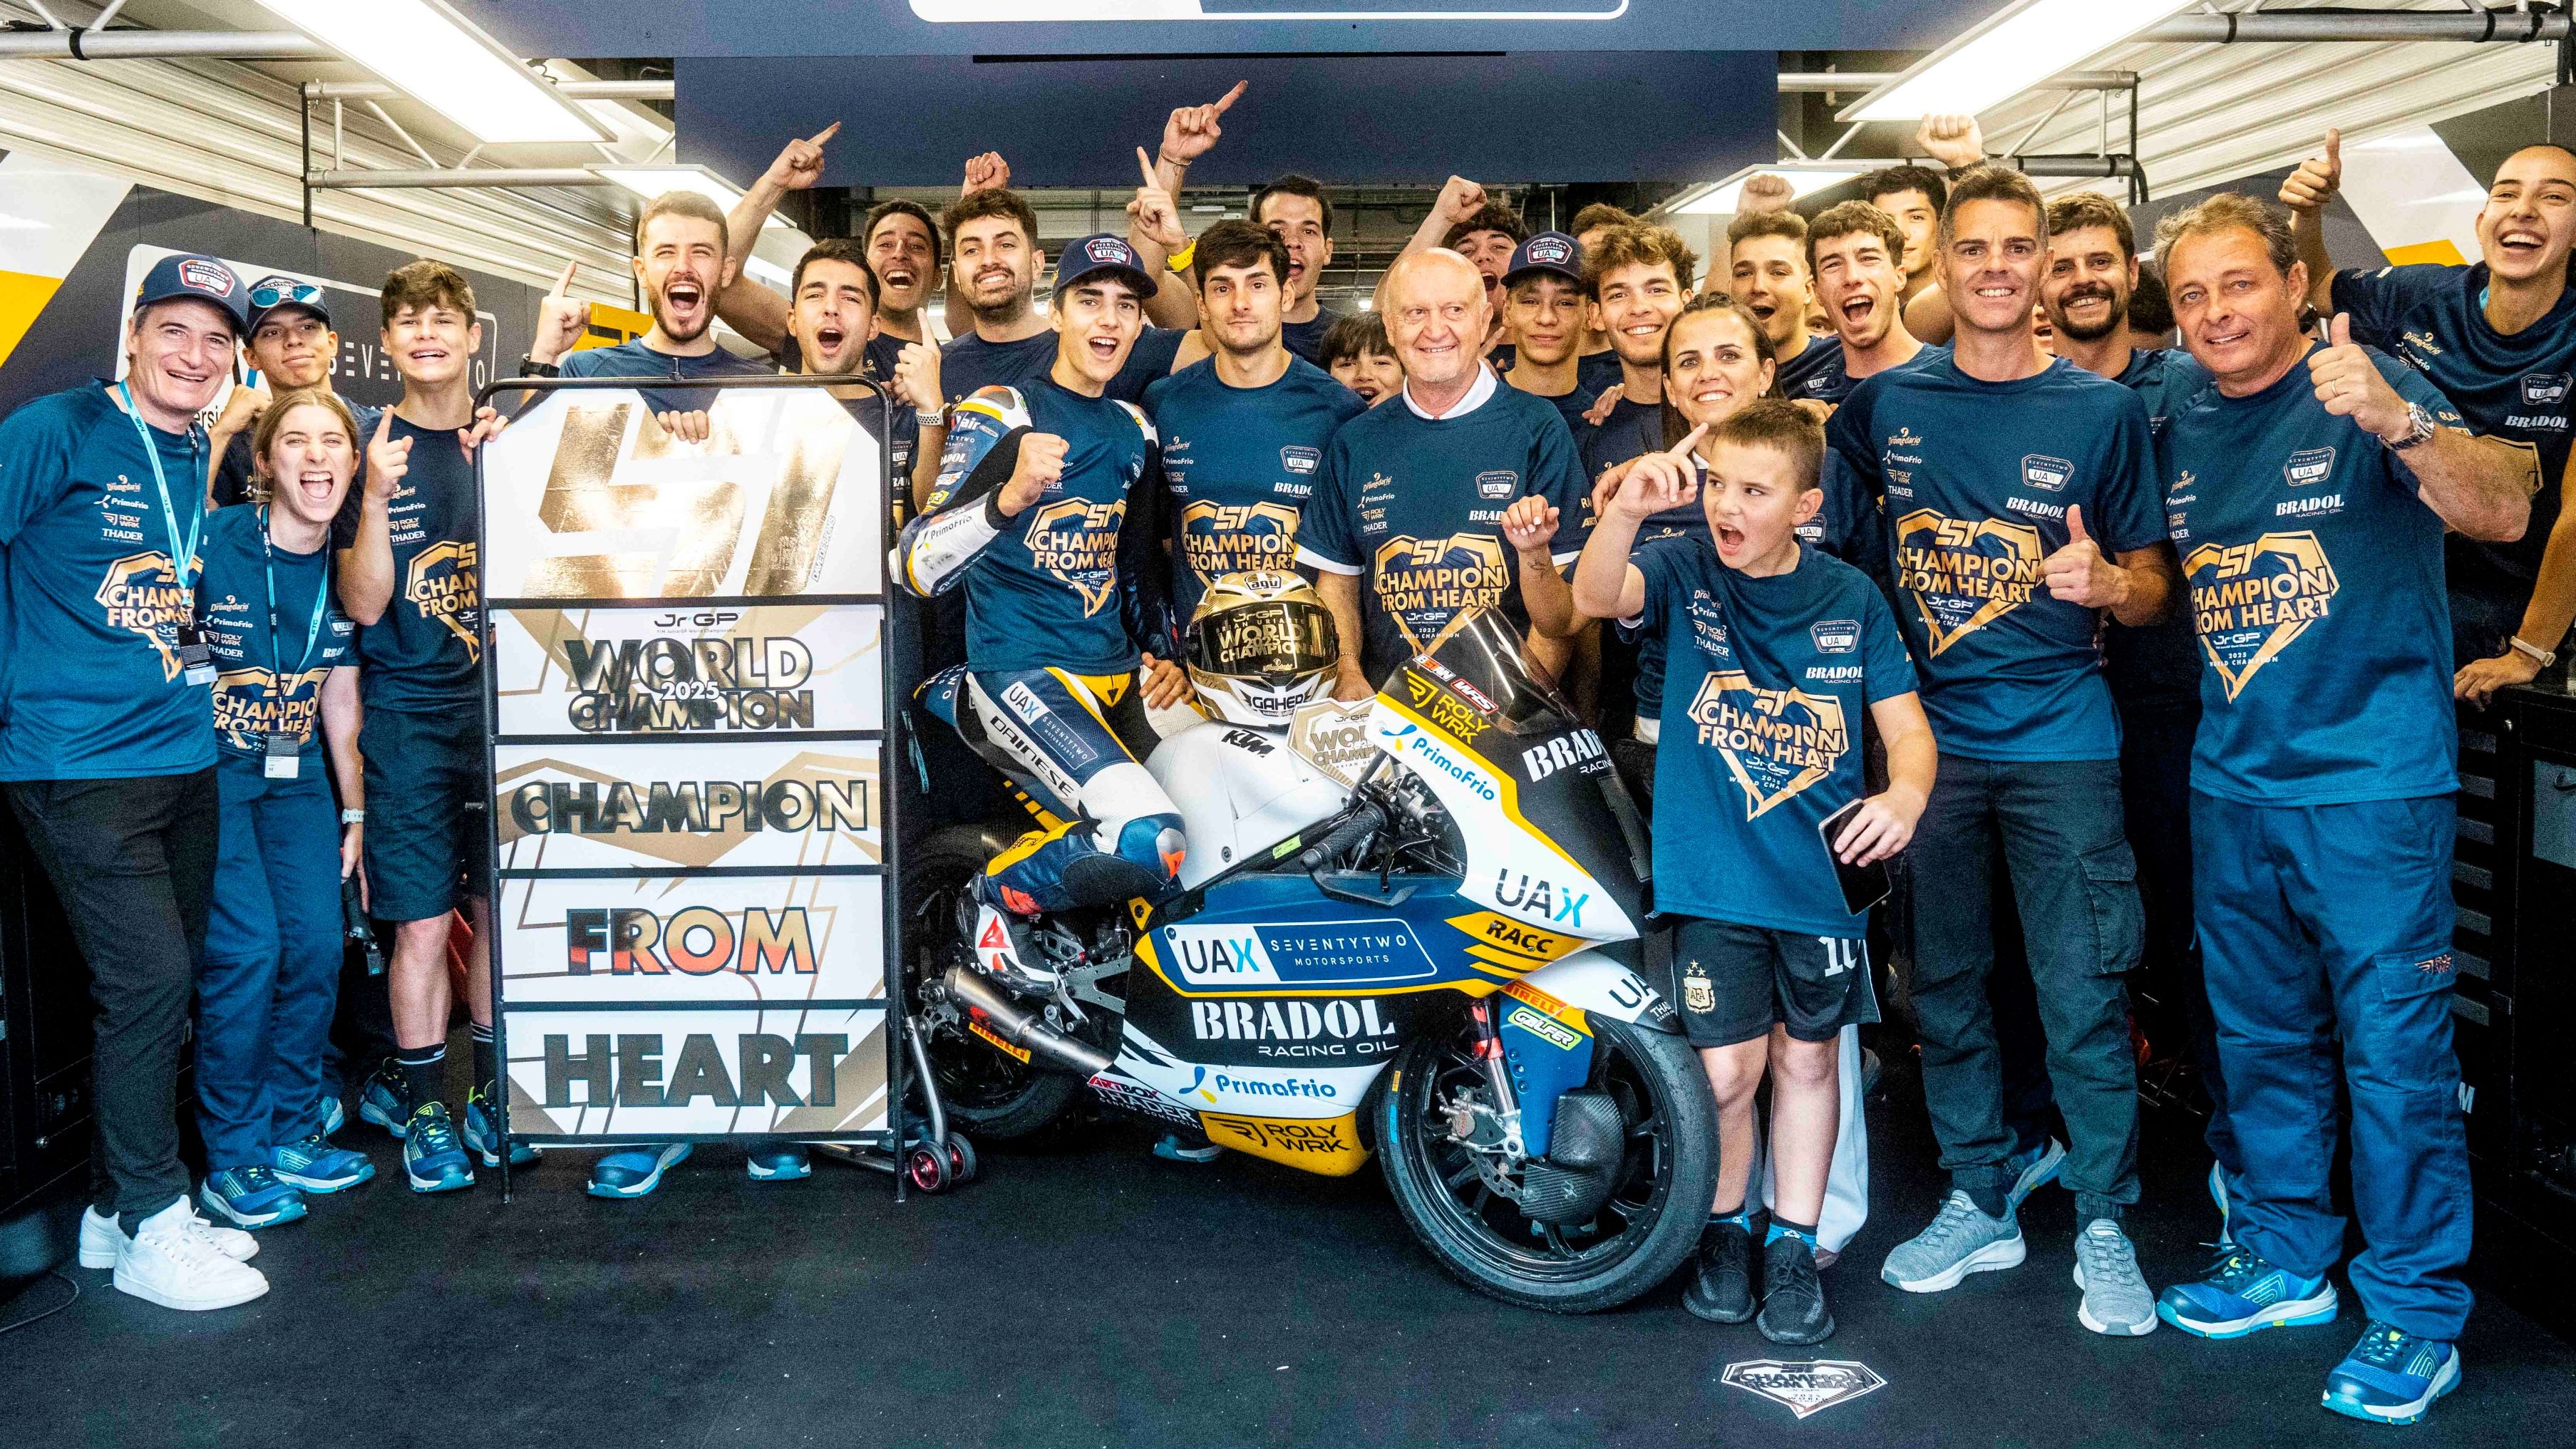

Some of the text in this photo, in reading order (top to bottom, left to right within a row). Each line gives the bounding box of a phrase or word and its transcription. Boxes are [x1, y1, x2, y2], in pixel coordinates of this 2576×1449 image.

[2505, 416, 2569, 428] BRADOL
[1891, 453, 1922, 464] PrimaFrio
[1363, 476, 1392, 493] Dromedario
[1897, 470, 1912, 478] ROLY
[1365, 493, 1395, 503] PrimaFrio
[1888, 485, 1912, 497] THADER
[2170, 494, 2196, 506] PrimaFrio
[111, 497, 148, 509] PrimaFrio
[388, 503, 426, 514] PrimaFrio
[2006, 497, 2064, 519] BRADOL
[2276, 494, 2344, 516] BRADOL
[400, 517, 419, 526] ROLY
[400, 522, 420, 530] WRK
[1083, 504, 1113, 528] 51
[1212, 506, 1252, 530] 51
[2023, 512, 2049, 522] RACING
[2173, 512, 2187, 520] ROLY
[102, 528, 143, 540] THADER
[391, 531, 426, 542] THADER
[931, 515, 972, 540] PrimaFrio
[1363, 521, 1387, 533] THADER
[1935, 518, 1979, 547] 51
[1184, 532, 1296, 554] CHAMPION
[1411, 540, 1448, 566] 51
[1034, 551, 1094, 569] FROM
[1187, 553, 1297, 571] FROM HEART
[1902, 547, 2039, 583] CHAMPION
[2216, 542, 2257, 579] 51
[1071, 572, 1109, 580] JrGP
[1251, 579, 1279, 589] agv
[1379, 566, 1505, 594] CHAMPION
[1899, 569, 2036, 603] FROM HEART
[210, 603, 249, 612] Dromedario
[418, 590, 478, 618] FROM
[1381, 587, 1503, 613] FROM HEART
[1926, 597, 1974, 609] JrGP
[2241, 593, 2331, 628] HEART
[108, 607, 172, 628] FROM
[213, 618, 253, 628] PrimaFrio
[654, 612, 739, 627] JrGP
[1233, 609, 1283, 622] JrGP
[1406, 612, 1448, 622] JrGP
[1918, 616, 1987, 631] WORLD CHAMPION
[1939, 613, 1959, 622] 2025
[1218, 622, 1305, 649] WORLD
[1244, 636, 1280, 649] 2025
[1694, 636, 1729, 656] THADER
[1709, 632, 1726, 642] WRK
[2213, 632, 2262, 645] JrGP
[208, 644, 244, 658] THADER
[1220, 641, 1307, 663] CHAMPION
[2232, 656, 2279, 666] CHAMPION
[564, 636, 813, 693] WORLD
[661, 681, 720, 700] 2025
[568, 689, 814, 732] CHAMPION
[1009, 686, 1040, 719] UAX
[1438, 693, 1491, 732] ROLY
[1334, 713, 1369, 723] JrGP
[1431, 706, 1478, 744] WRK
[1699, 699, 1842, 751] CHAMPION
[1042, 716, 1088, 760] SEVENTYTWO
[1043, 729, 1075, 759] MOTORSPORTS
[1221, 729, 1275, 758] KTM
[1698, 726, 1769, 757] FROM
[990, 715, 1074, 798] DAINESE
[1313, 746, 1376, 766] CHAMP
[1522, 728, 1605, 783] BRAD
[1413, 737, 1495, 800] PrimaFrio
[511, 780, 868, 834] CHAMPION
[1495, 868, 1590, 928] UAX
[567, 906, 818, 976] FROM
[1485, 919, 1554, 954] RACC
[1182, 934, 1407, 974] UAX SEVENTYTWO
[1294, 955, 1390, 966] MOTORSPORTS
[1191, 999, 1396, 1040] BRADOL
[1513, 1010, 1575, 1047] GALFER
[972, 1023, 1026, 1059] PIRELLI
[1258, 1041, 1400, 1056] RACING OIL
[544, 1033, 848, 1108] HEART
[1088, 1076, 1162, 1102] ARTBOX
[1215, 1074, 1336, 1098] PrimaFrio
[1096, 1086, 1197, 1123] THADER
[1099, 1098, 1204, 1130] CENTRO COMERCIAL
[1264, 1124, 1337, 1139] ROLY
[1275, 1137, 1351, 1153] WRK
[1739, 1373, 1867, 1383] CHAMPION
[1743, 1380, 1802, 1389] FROM
